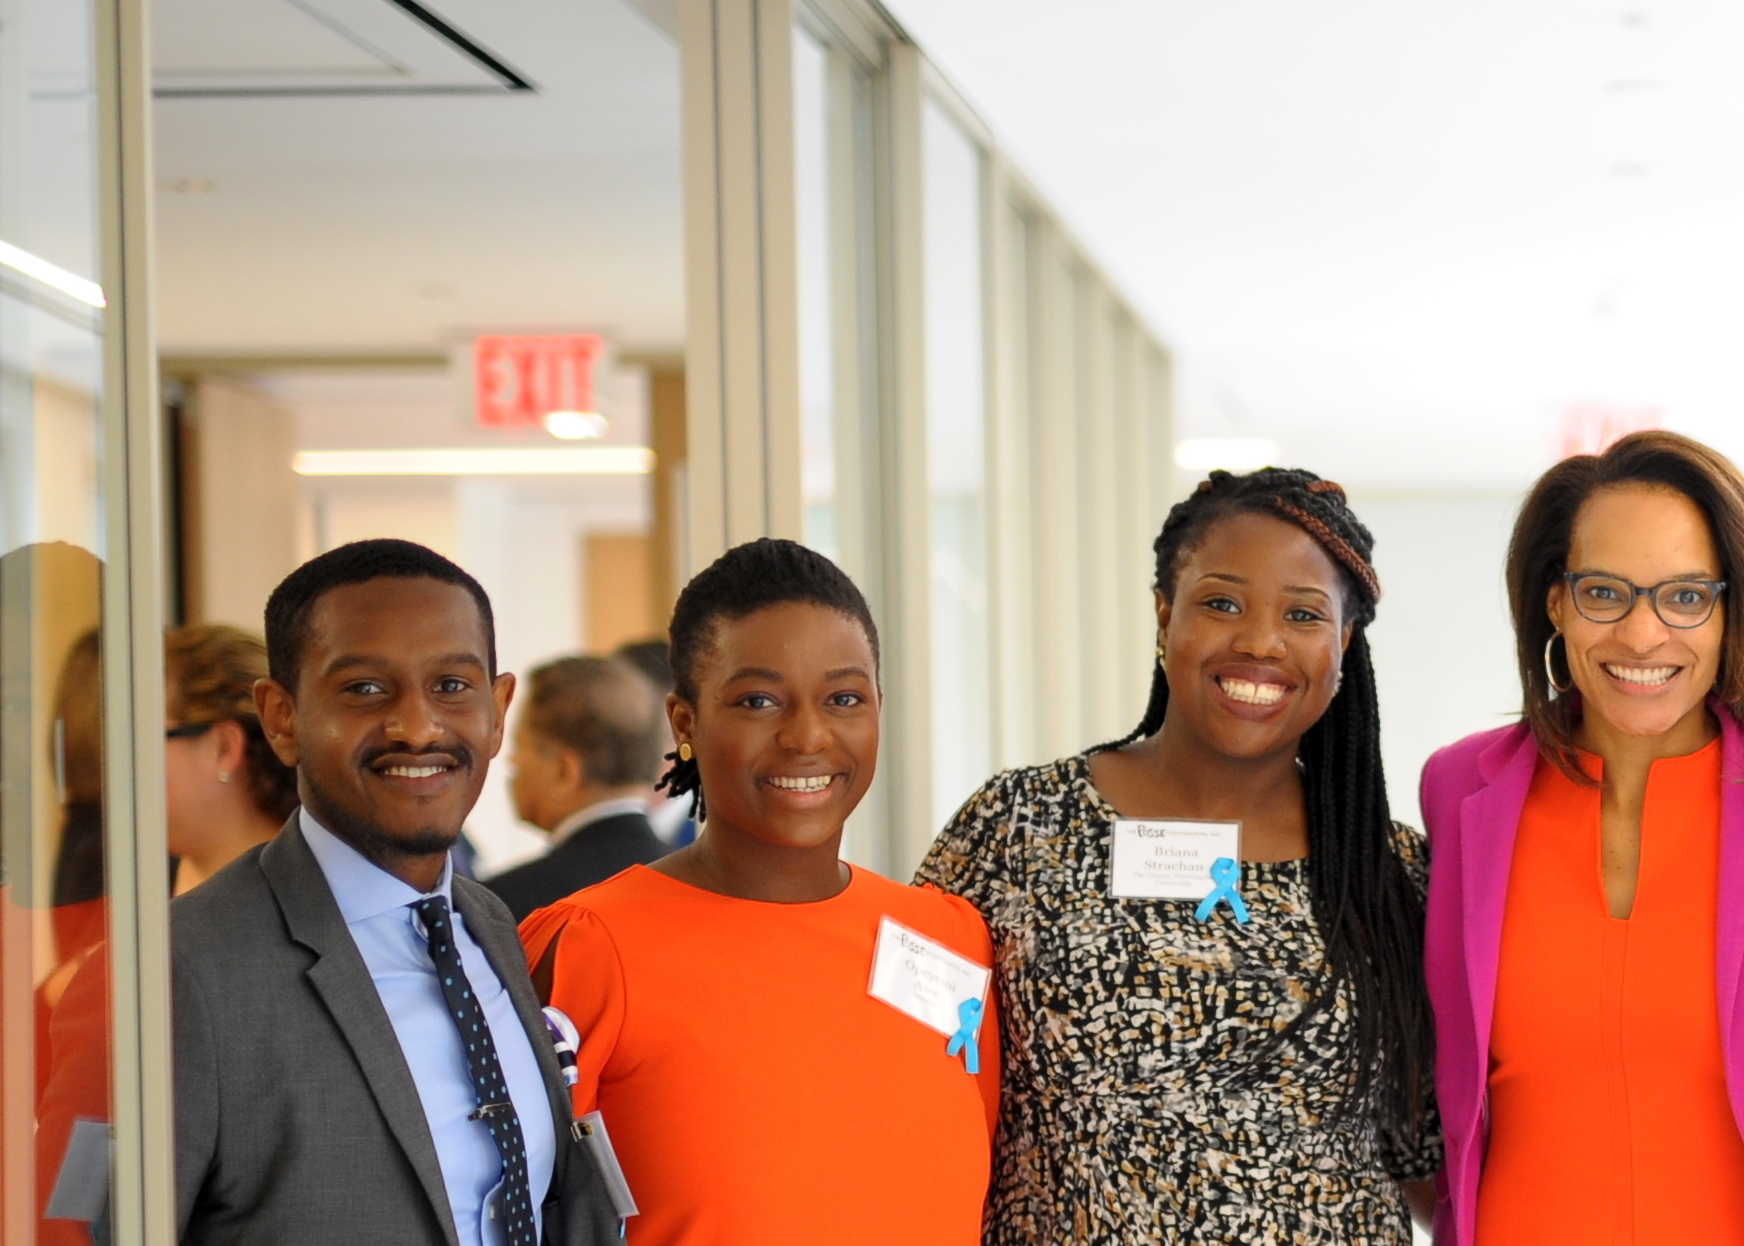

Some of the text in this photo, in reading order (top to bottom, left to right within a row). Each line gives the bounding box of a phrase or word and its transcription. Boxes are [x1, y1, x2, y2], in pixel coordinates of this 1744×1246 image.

[474, 334, 605, 430] EXIT
[1137, 824, 1166, 838] POSSE
[1155, 846, 1199, 858] Briana
[1143, 860, 1204, 872] Strachan
[905, 959, 957, 993] Opeyemi
